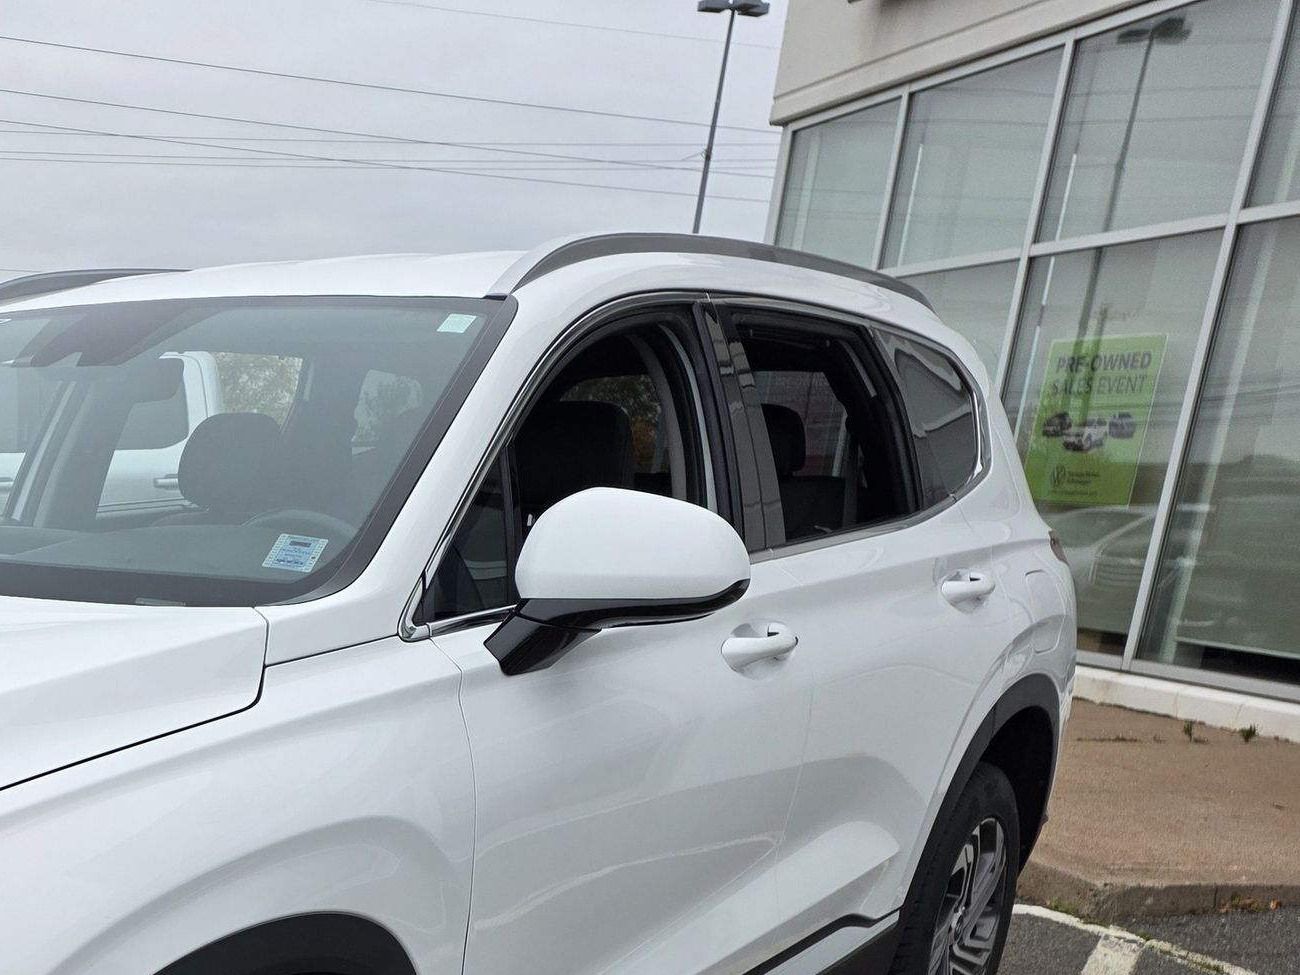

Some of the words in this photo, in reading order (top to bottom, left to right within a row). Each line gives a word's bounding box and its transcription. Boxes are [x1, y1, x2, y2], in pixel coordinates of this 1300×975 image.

[1056, 351, 1152, 373] PRE-OWNED
[1051, 376, 1094, 396] SALES
[1097, 374, 1148, 395] EVENT
